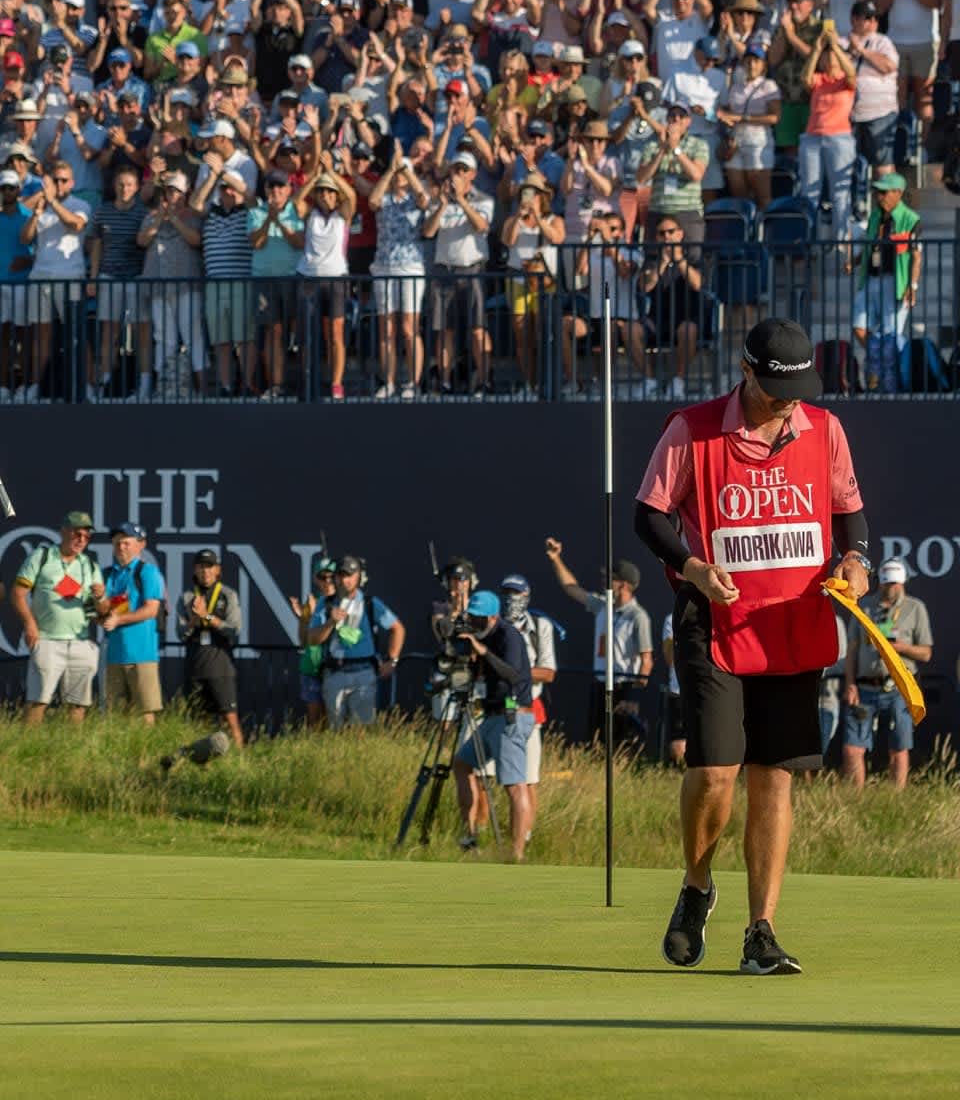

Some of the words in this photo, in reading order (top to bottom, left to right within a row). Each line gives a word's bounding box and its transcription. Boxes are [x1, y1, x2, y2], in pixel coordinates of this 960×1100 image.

[746, 466, 788, 487] THE
[75, 468, 223, 534] THE
[718, 483, 814, 520] OPEN
[723, 531, 815, 564] MORIKAWA
